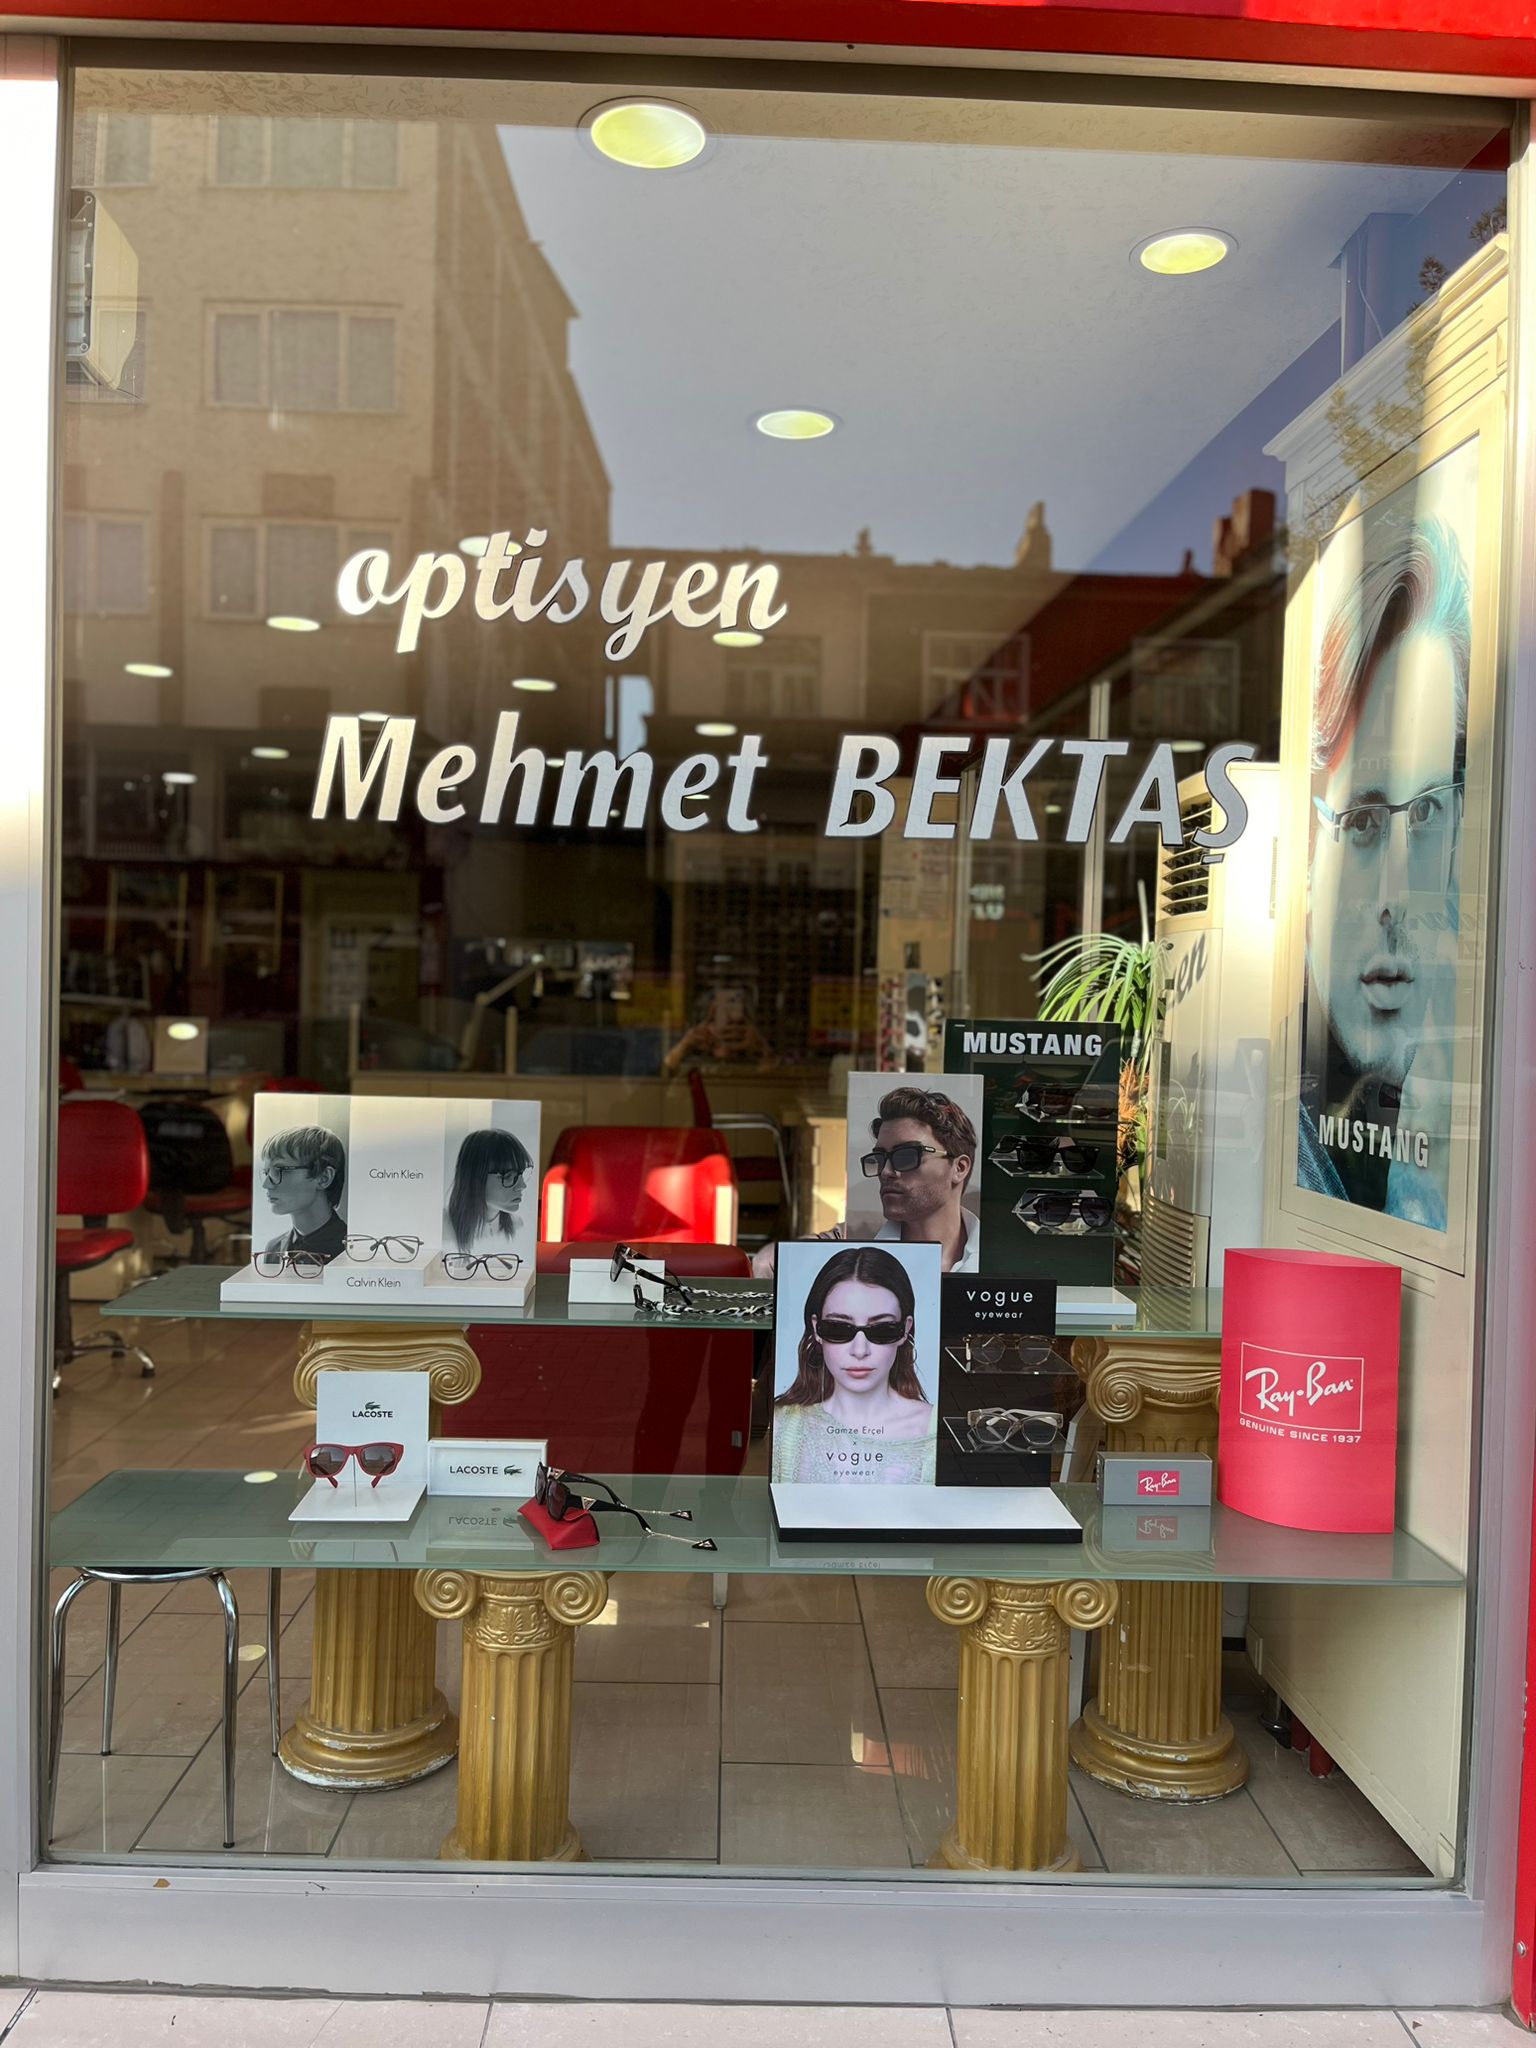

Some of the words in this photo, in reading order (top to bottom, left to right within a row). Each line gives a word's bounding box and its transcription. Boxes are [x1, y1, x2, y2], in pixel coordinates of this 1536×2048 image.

[337, 528, 789, 661] optisyen
[311, 710, 769, 833] Mehmet
[963, 1032, 1103, 1057] MUSTANG
[1318, 1113, 1430, 1169] MUSTANG
[369, 1168, 400, 1180] Calvin
[400, 1168, 424, 1180] Klein
[346, 1276, 377, 1288] Calvin
[377, 1276, 401, 1288] Klein
[966, 1290, 1034, 1307] vogue
[974, 1311, 1024, 1320] eyewear
[352, 1410, 393, 1419] LACOSTE
[826, 1425, 859, 1435] Gamze
[1239, 1417, 1285, 1437] GENUINE
[1289, 1430, 1328, 1443] SINCE
[1333, 1435, 1362, 1444] 1937
[826, 1452, 884, 1466] vogue
[449, 1465, 499, 1475] LACOSTE
